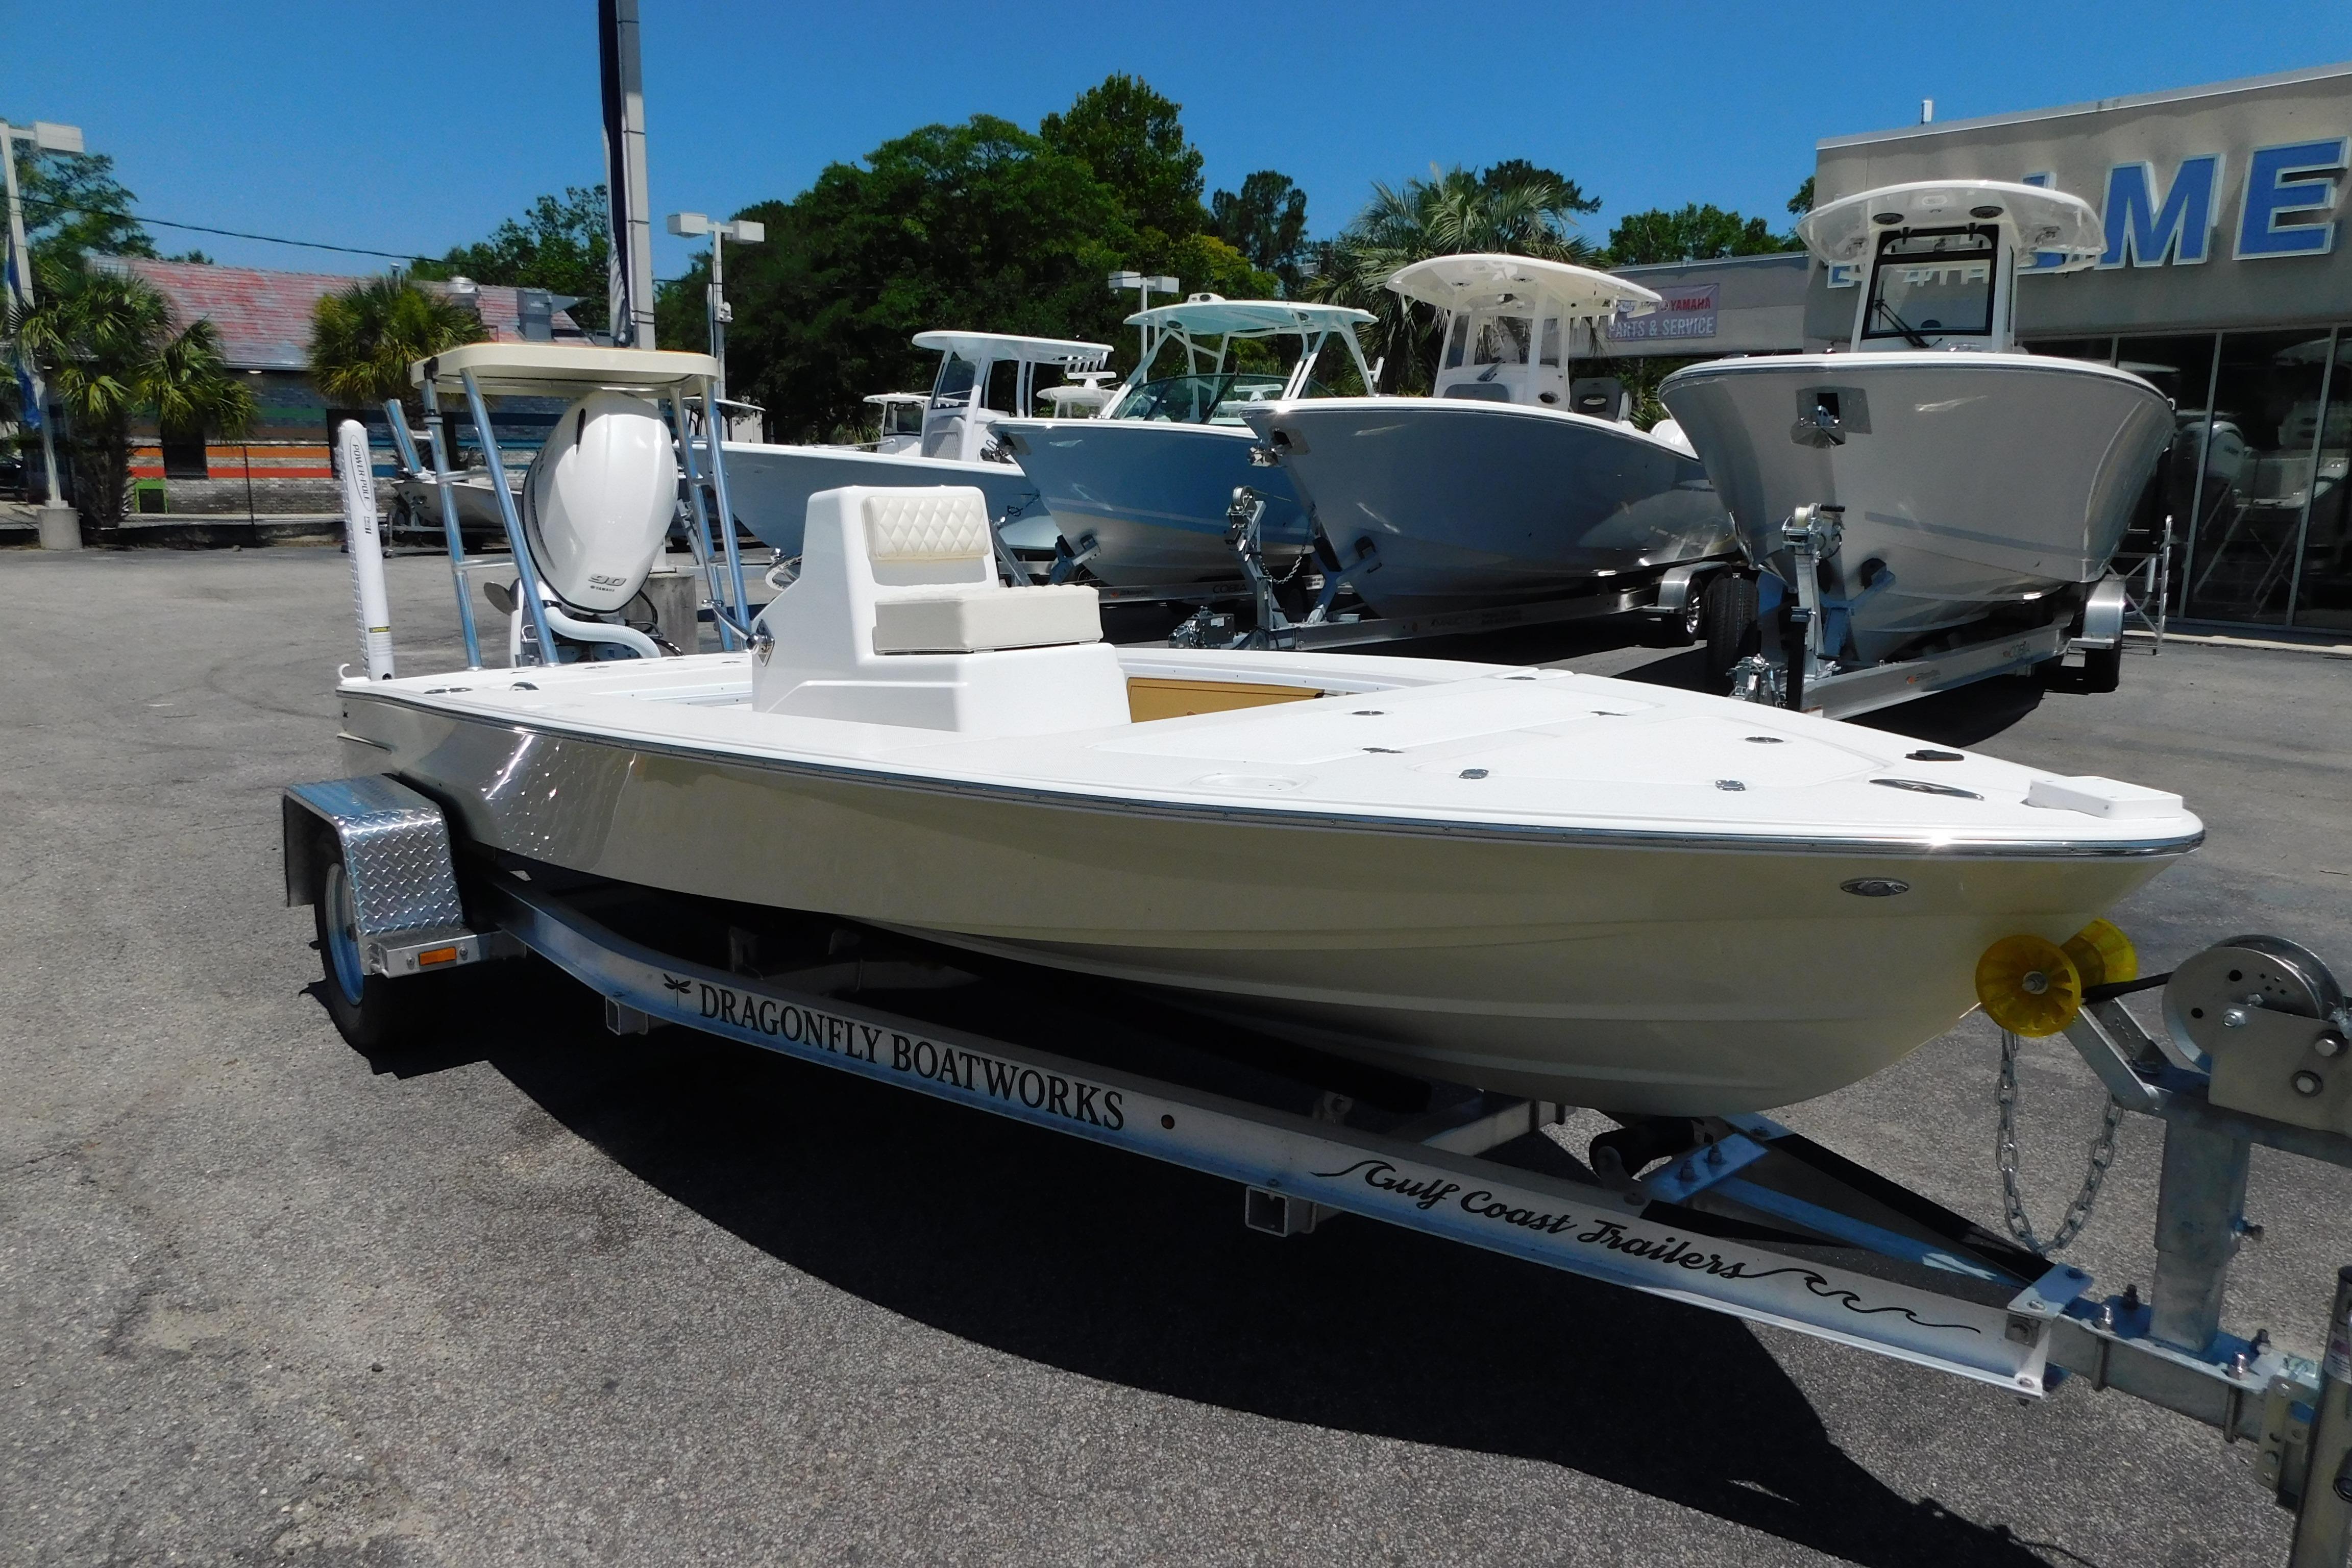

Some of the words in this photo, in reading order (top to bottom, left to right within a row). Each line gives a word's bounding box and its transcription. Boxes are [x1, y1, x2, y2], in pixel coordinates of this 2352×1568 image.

[1671, 296, 1711, 311] YAMAHA
[1608, 320, 1645, 338] PARTS
[1649, 320, 1658, 336] &
[1662, 316, 1714, 336] SERVICE
[352, 444, 371, 500] POWER-POLE
[588, 574, 627, 586] 90
[699, 983, 883, 1064] DRAGONFLY
[891, 1034, 1124, 1131] BOATWORKS
[1364, 1160, 1460, 1210] Gulf
[1460, 1191, 1578, 1234] Coast
[1577, 1219, 1746, 1279] Trailers
